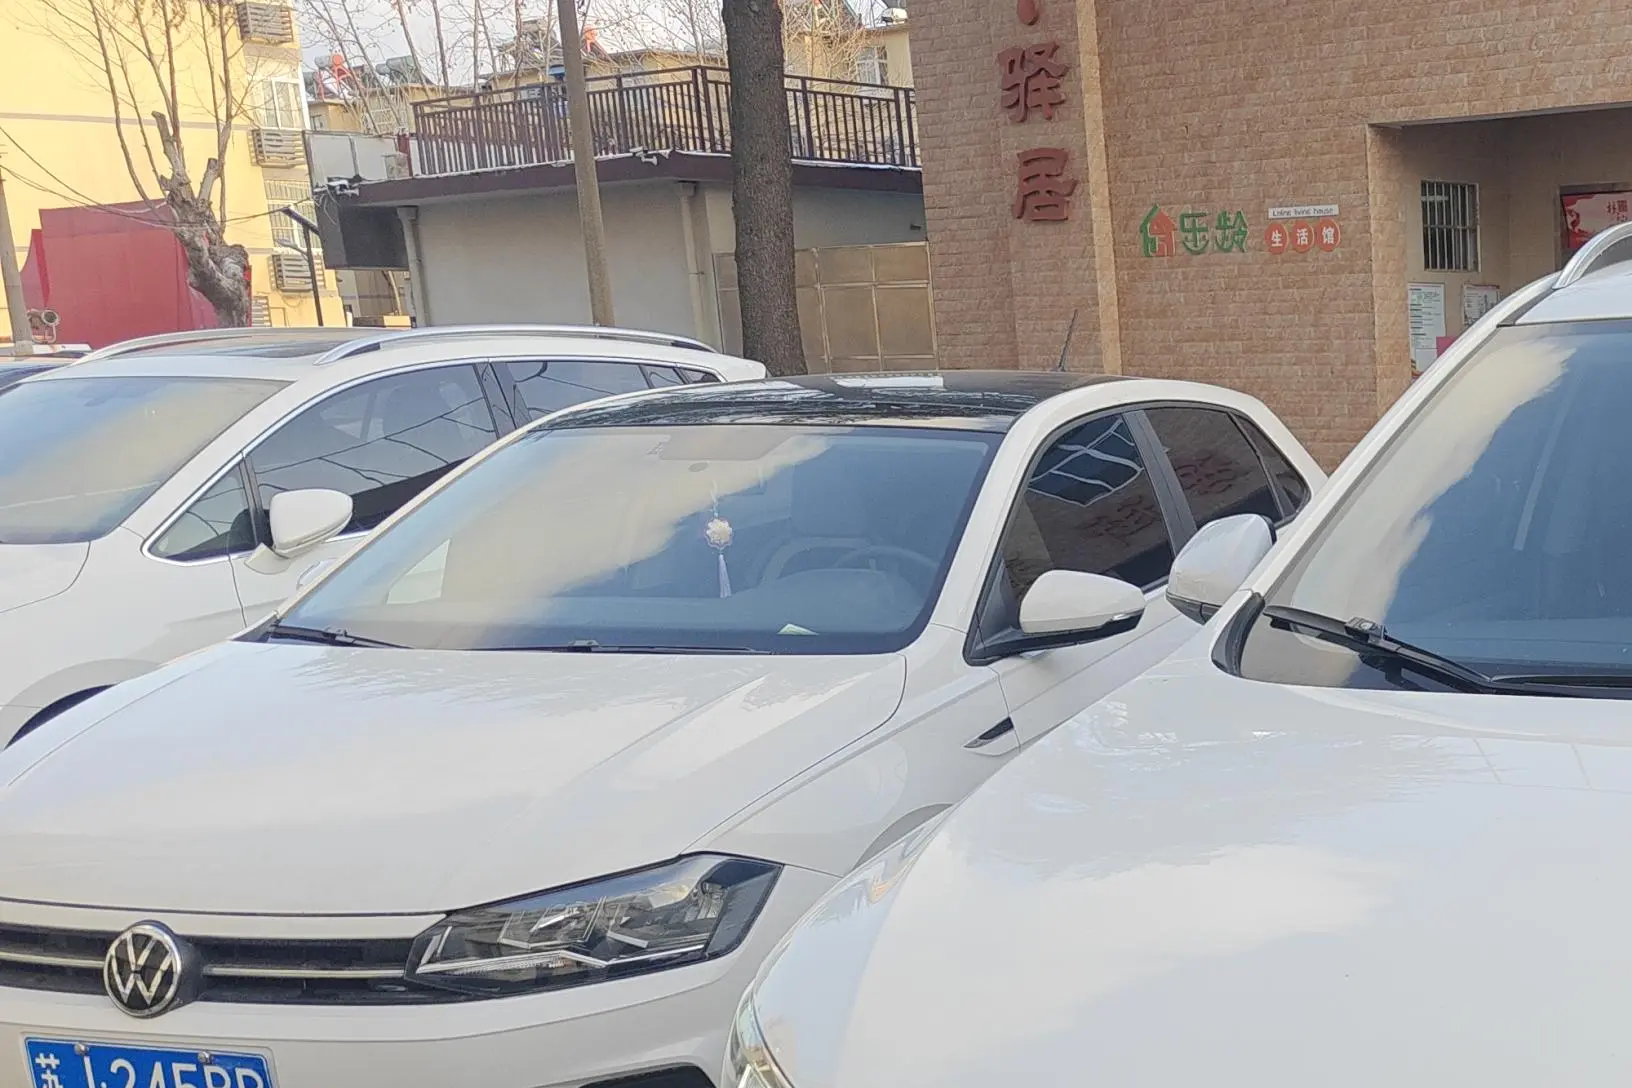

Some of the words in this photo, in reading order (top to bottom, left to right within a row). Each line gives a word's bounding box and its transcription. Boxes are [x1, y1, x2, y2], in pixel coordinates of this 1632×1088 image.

[997, 0, 1078, 222] 驿居
[1180, 208, 1248, 255] 乐龄
[1271, 225, 1336, 248] 生活馆
